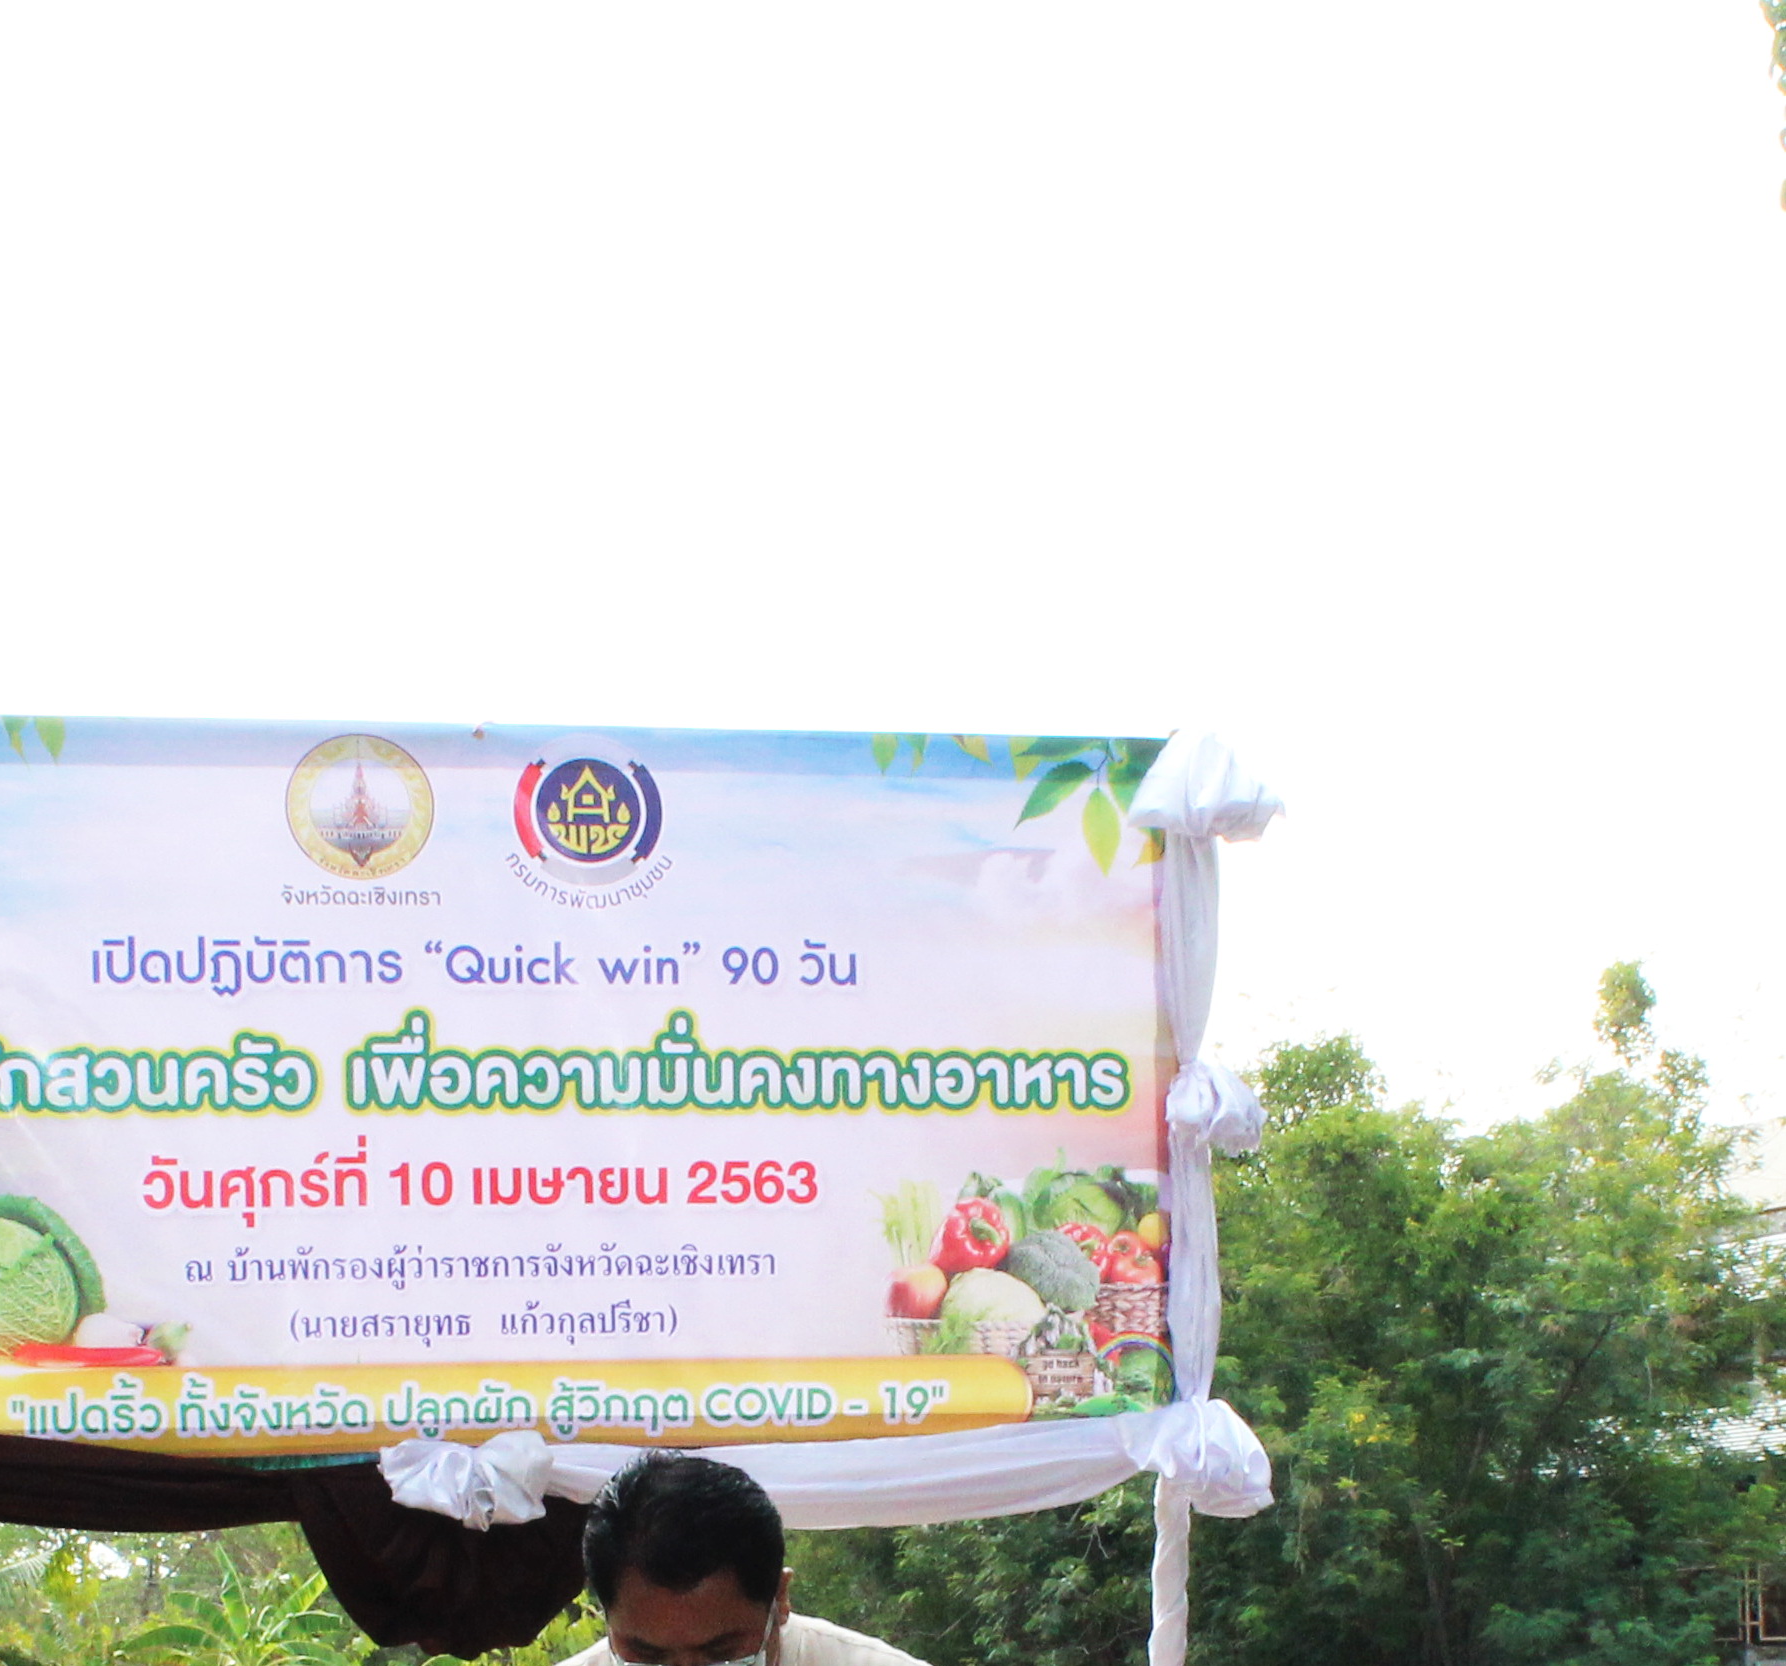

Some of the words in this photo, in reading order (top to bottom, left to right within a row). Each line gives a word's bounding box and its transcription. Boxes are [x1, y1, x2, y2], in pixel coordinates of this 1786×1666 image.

[281, 883, 441, 906] จังหวัดฉะเชิงเทรา
[505, 852, 673, 909] กรมการพัฒนาชุมชน
[92, 935, 403, 996] เปิดปฏิบัติการ
[424, 939, 579, 985] “Quick
[598, 941, 701, 985] win”
[722, 946, 779, 985] 90
[800, 938, 857, 985] วัน
[347, 1011, 1130, 1110] เพื่อความมั่นคงทางอาหาร
[143, 1135, 367, 1228] วันศุกร์ที่
[390, 1161, 454, 1206] 10
[472, 1163, 668, 1206] เมษายน
[686, 1160, 818, 1205] 2563
[185, 1259, 213, 1283] ณ
[228, 1243, 777, 1290] บ้านพักรองผู้ว่าราชการจังหวัดฉะเชิงเทรา
[290, 1311, 472, 1347] (นายสรายุทธ
[500, 1300, 679, 1347] แก้วกุลปรีชา)
[11, 1378, 162, 1435] "แปดริ้ว
[180, 1376, 369, 1433] ทั้งจังหวัด
[386, 1384, 531, 1437] ปลูกผัก
[550, 1382, 689, 1437] สู้วิกฤต
[705, 1388, 833, 1423] COVID
[884, 1386, 944, 1420] 19"
